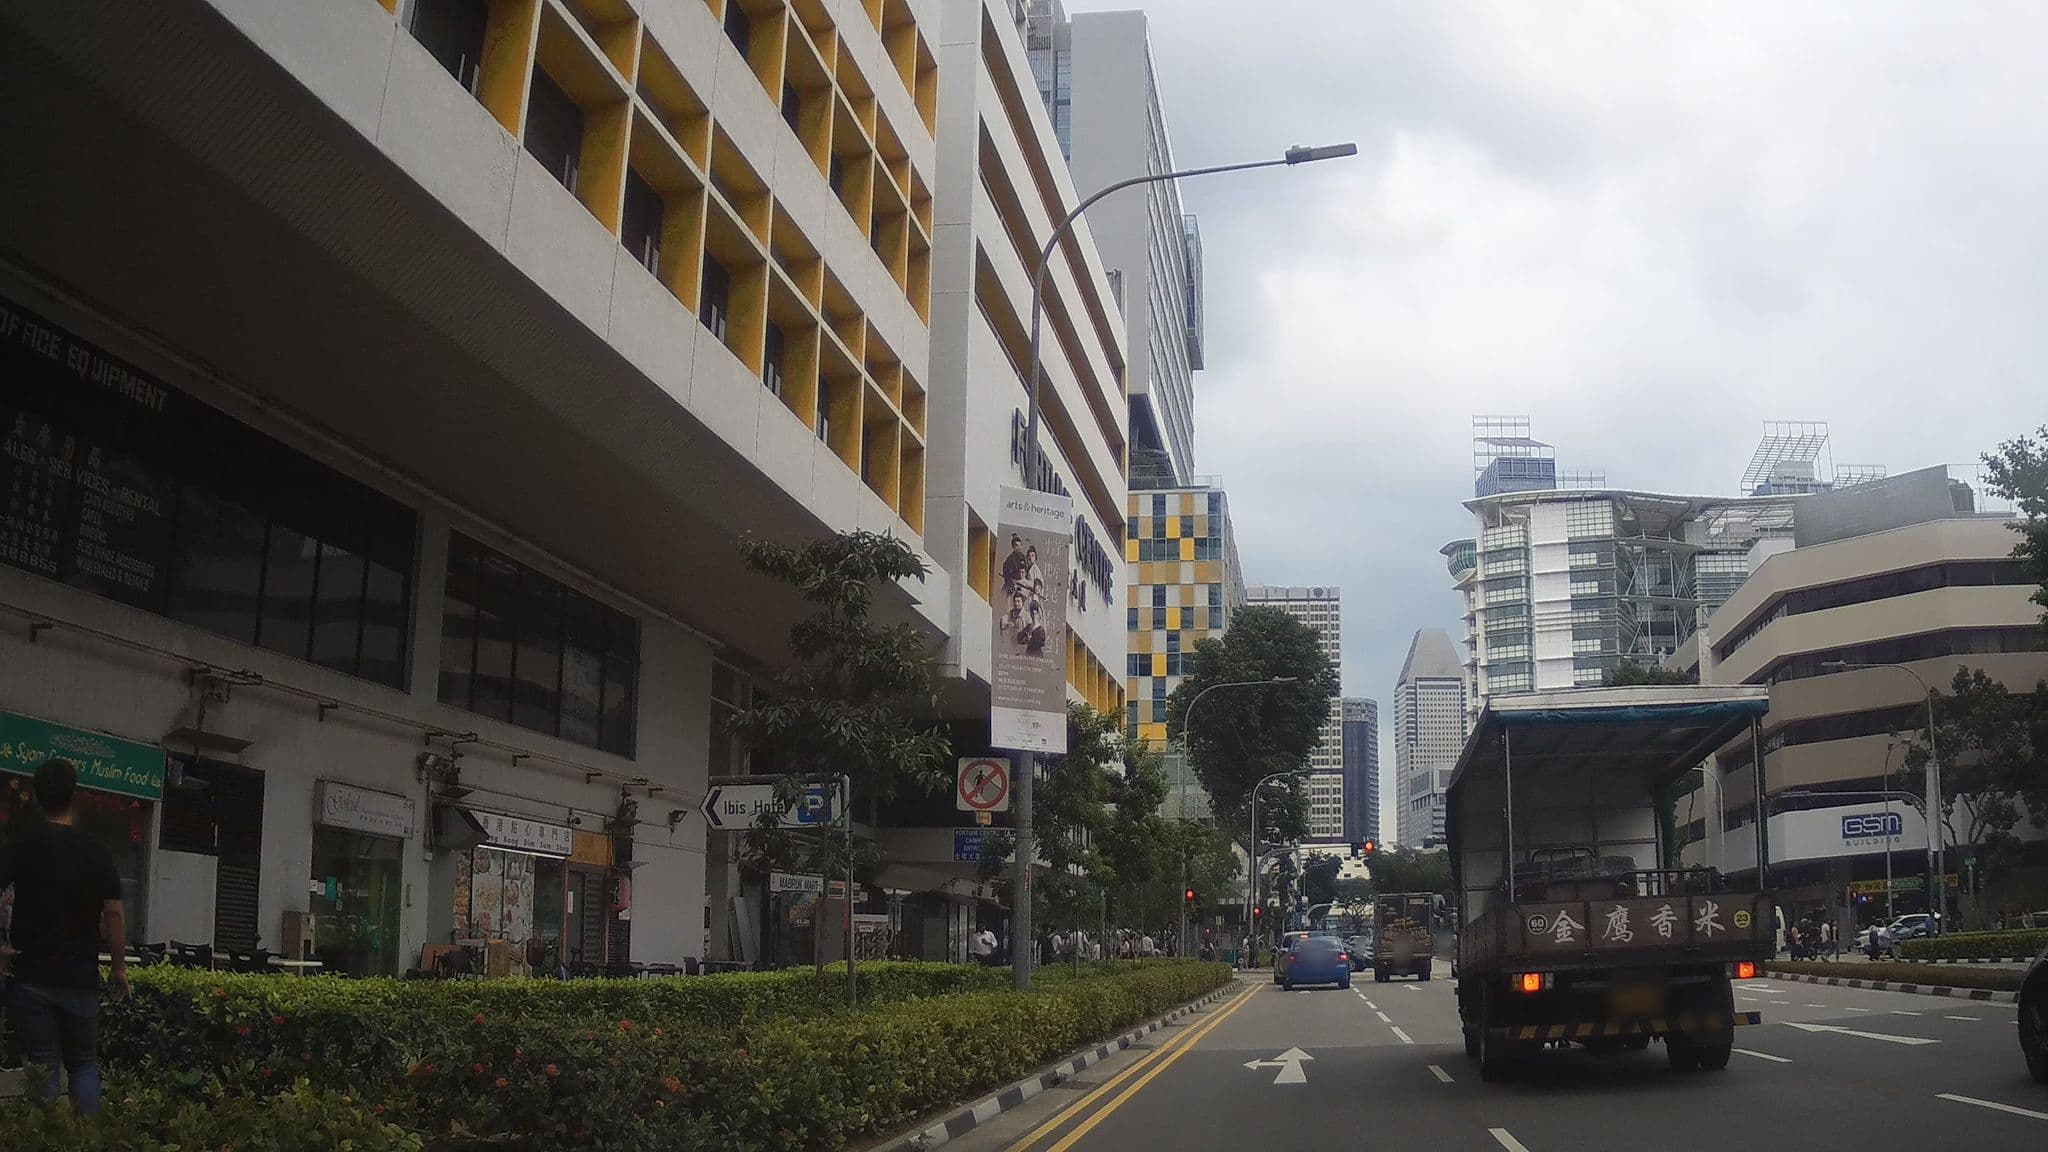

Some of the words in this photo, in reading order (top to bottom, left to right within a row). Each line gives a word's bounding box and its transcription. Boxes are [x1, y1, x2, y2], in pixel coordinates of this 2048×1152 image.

[1006, 500, 1023, 510] arts
[1031, 503, 1065, 519] heritage
[91, 759, 122, 780] Muslim
[124, 766, 149, 786] Food
[724, 800, 746, 815] Ibis
[539, 840, 552, 849] Sum
[1530, 918, 1545, 928] 60
[1736, 913, 1748, 922] 23
